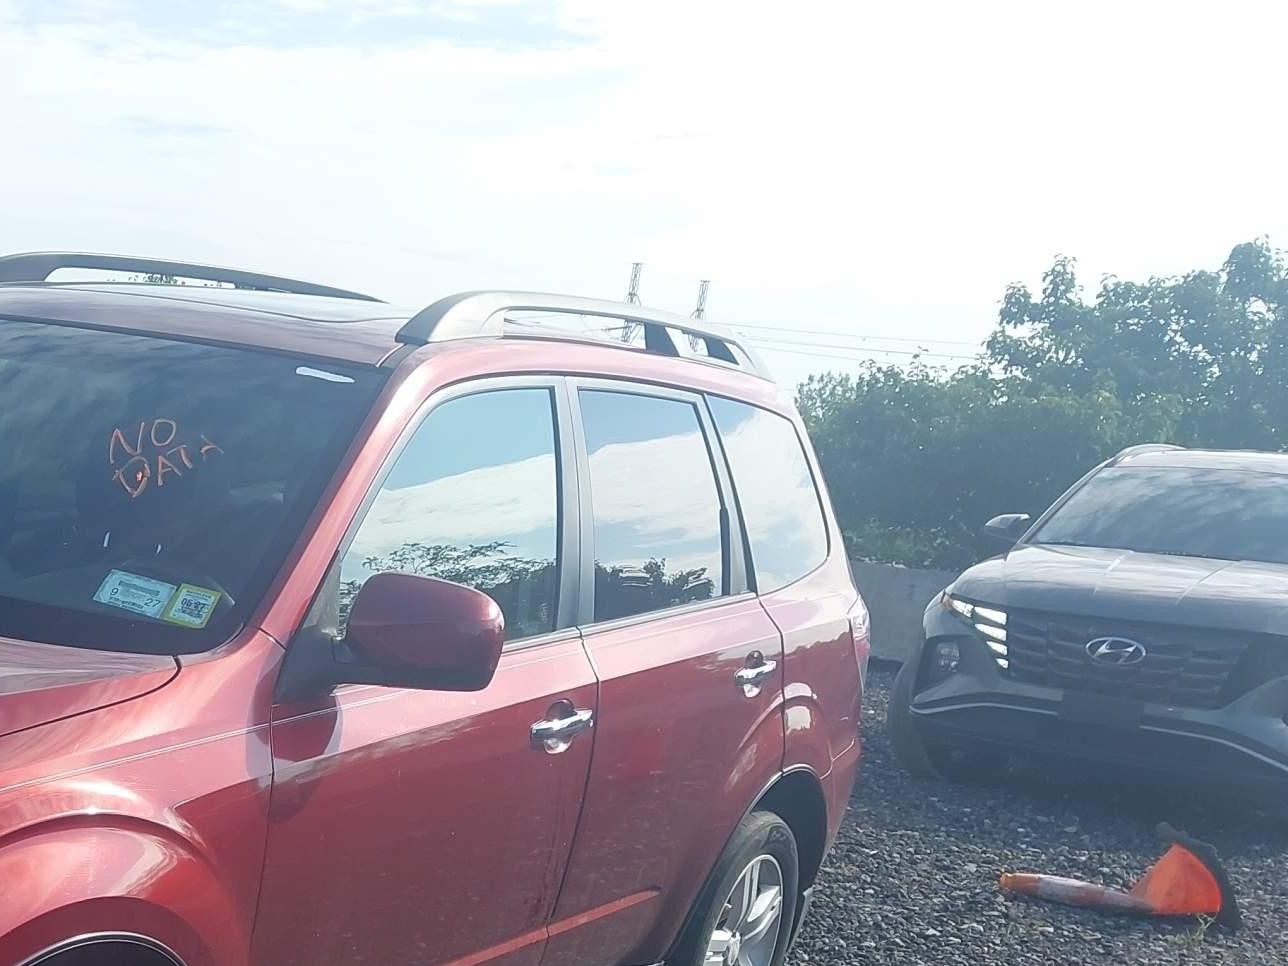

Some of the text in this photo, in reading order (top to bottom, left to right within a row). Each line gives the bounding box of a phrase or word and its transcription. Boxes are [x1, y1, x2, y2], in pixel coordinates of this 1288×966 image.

[109, 418, 177, 464] NO
[109, 587, 119, 596] 9
[143, 597, 161, 609] 27
